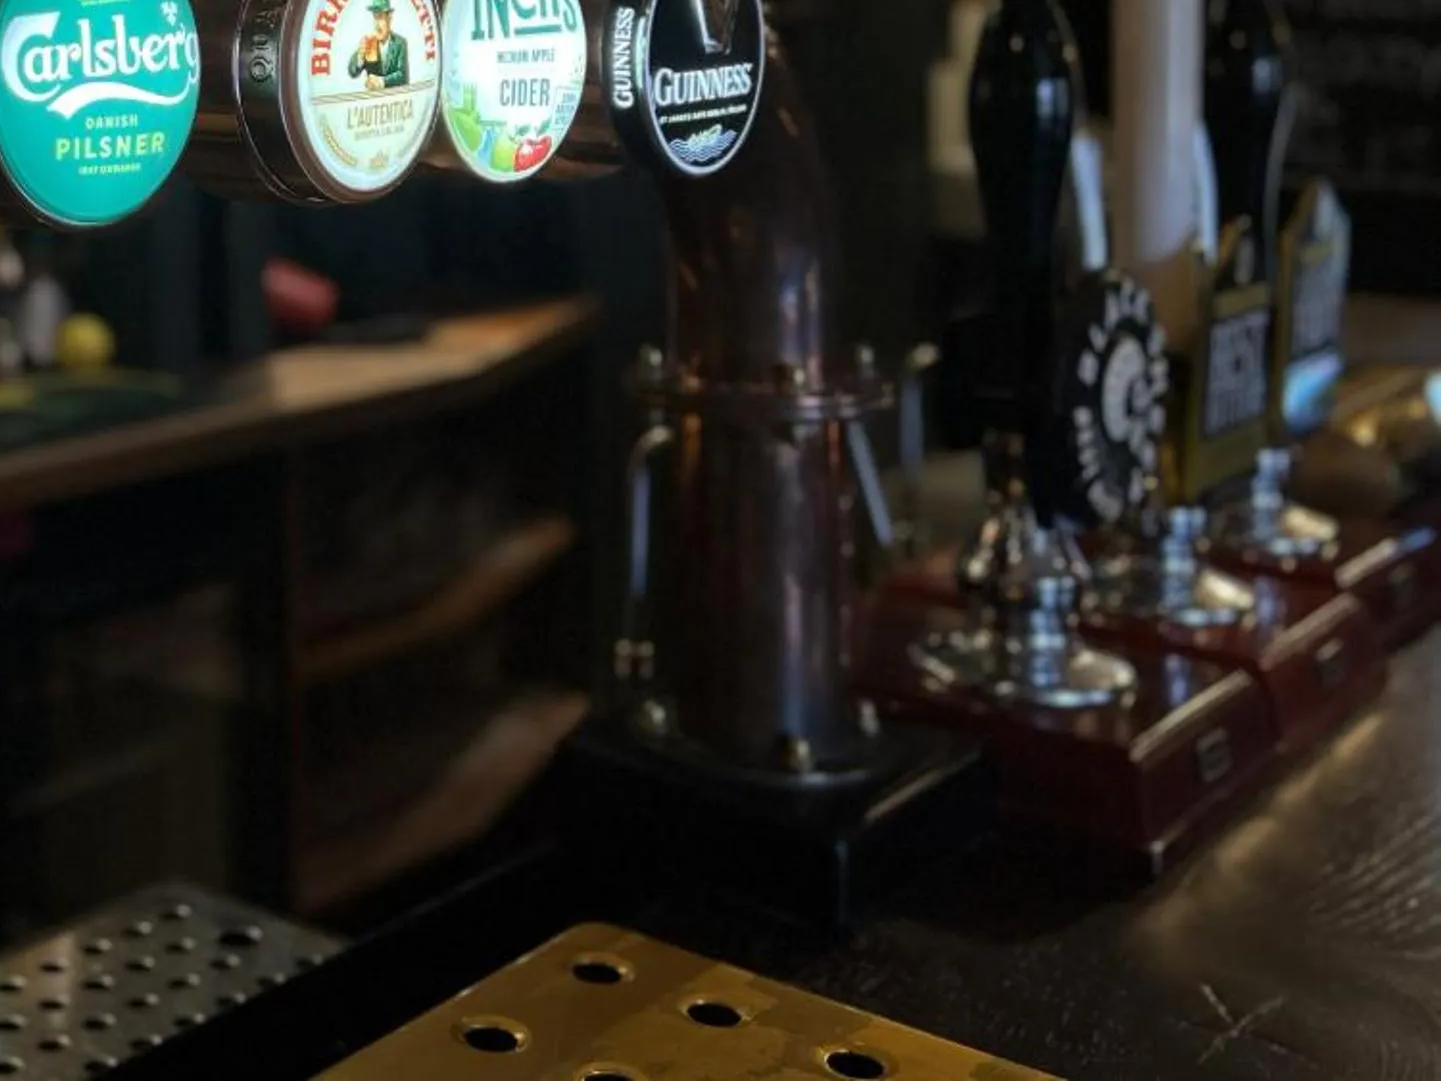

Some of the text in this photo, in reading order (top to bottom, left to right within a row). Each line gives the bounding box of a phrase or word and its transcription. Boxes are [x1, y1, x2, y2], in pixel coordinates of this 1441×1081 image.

[0, 10, 201, 104] Carlsberg
[612, 6, 636, 110] GUINNESS
[499, 78, 551, 108] CIDER
[653, 62, 755, 107] GUINNESS
[84, 114, 138, 131] DANISH
[54, 131, 166, 161] PILSNER
